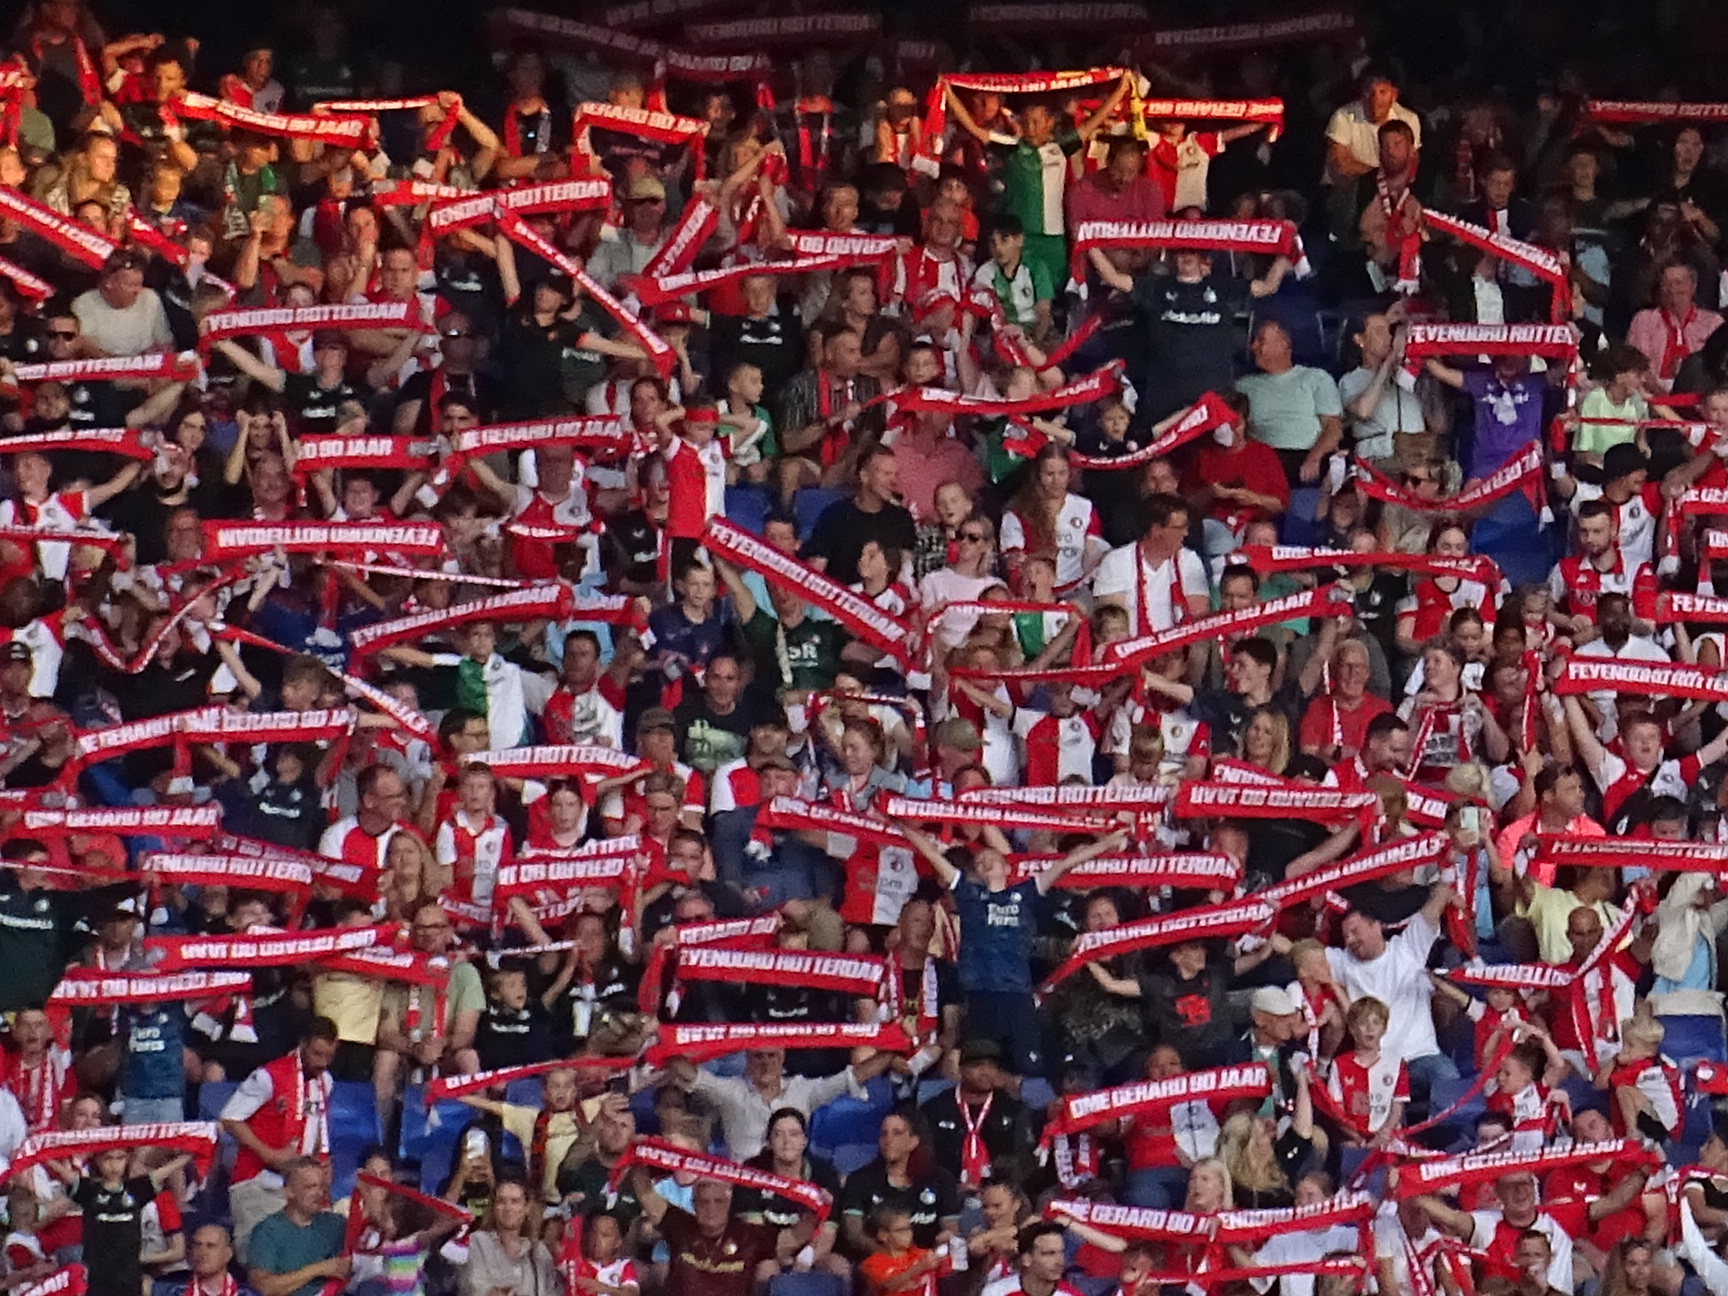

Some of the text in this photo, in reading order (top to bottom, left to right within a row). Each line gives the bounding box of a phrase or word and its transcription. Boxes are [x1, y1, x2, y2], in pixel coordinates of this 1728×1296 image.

[1068, 1065, 1269, 1119] OME GERARD 90 JAAR
